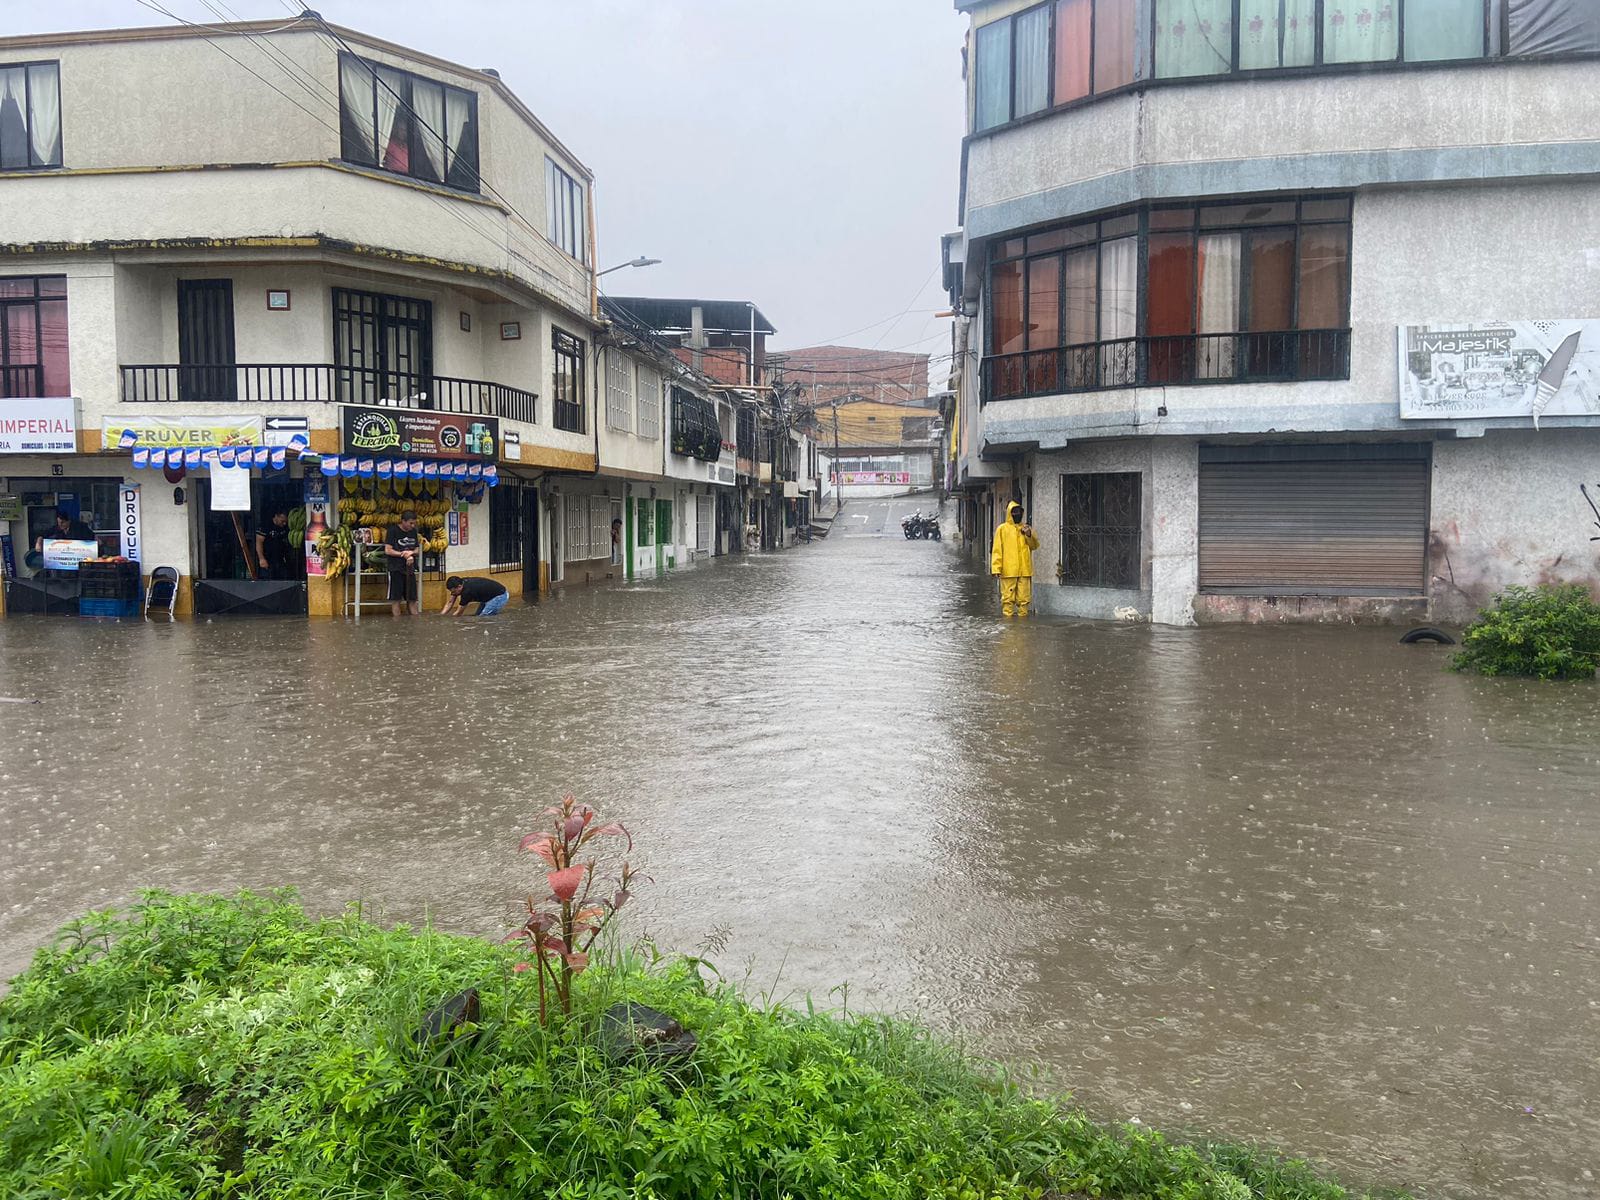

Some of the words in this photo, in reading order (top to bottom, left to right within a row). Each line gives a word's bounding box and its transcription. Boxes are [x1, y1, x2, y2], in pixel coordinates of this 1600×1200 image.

[1457, 330, 1514, 339] RESTAURACIONES
[1423, 338, 1508, 353] Majestik
[0, 419, 74, 434] IMPERIAL
[355, 414, 390, 432] ESTANQUILLO
[136, 429, 212, 442] FRUVER
[354, 435, 397, 447] FERCHOS
[125, 490, 137, 559] DROGUE
